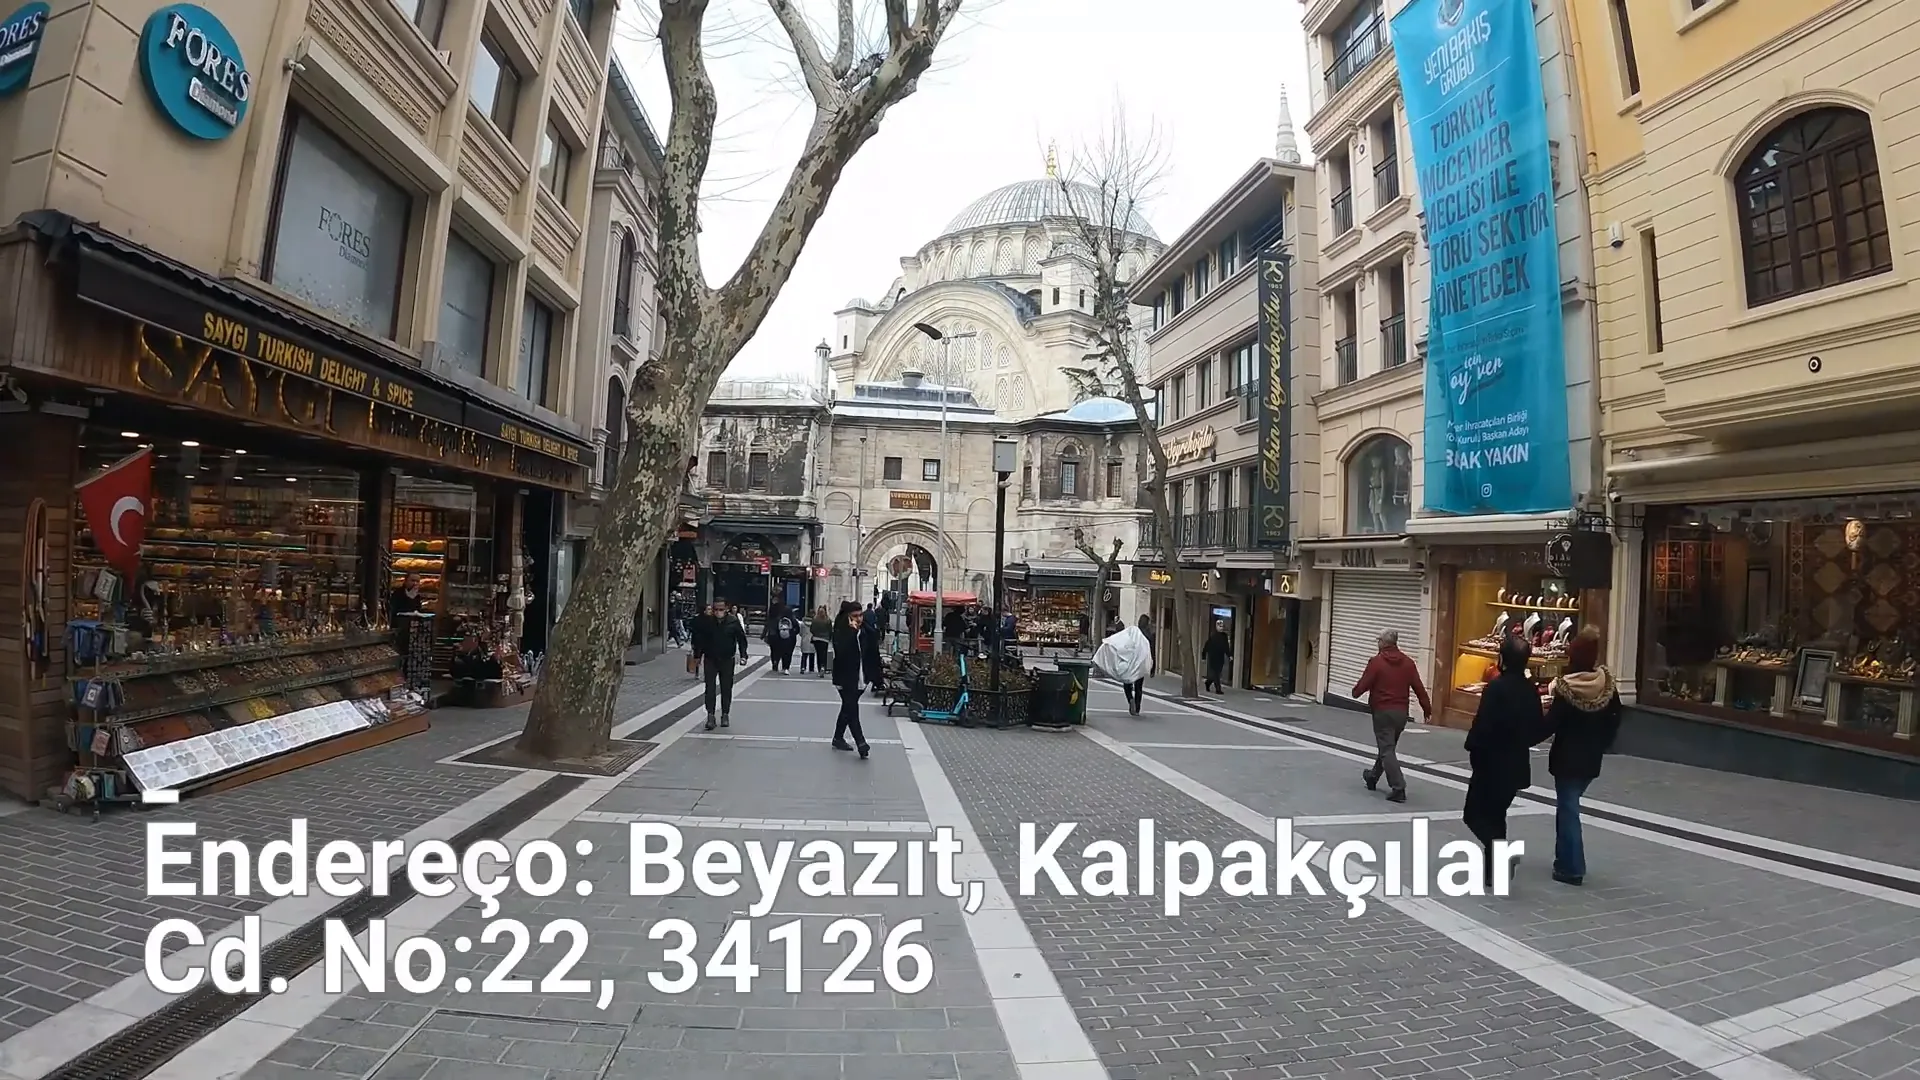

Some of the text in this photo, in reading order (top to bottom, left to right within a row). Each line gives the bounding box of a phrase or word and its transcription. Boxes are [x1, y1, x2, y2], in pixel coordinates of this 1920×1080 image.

[166, 12, 251, 102] FORES
[1440, 51, 1475, 96] GRUBU
[191, 80, 238, 126] Diamond
[1430, 84, 1497, 153] TÜRKİYE
[1422, 121, 1513, 199] MÜCEVHER
[318, 205, 371, 258] FORES
[1424, 159, 1520, 237] MECLİSİ İLE
[1431, 192, 1549, 276] TÖRÜ SEKTÖR
[1435, 252, 1530, 319] ÖNETECEK
[203, 312, 414, 408] SAYGI TURKISH DELIGHT & SPICE
[1450, 357, 1503, 405] oy ver
[1263, 424, 1281, 495] Tekin
[1445, 442, 1529, 470] BAK YAKIN
[1482, 429, 1507, 442] Başkan
